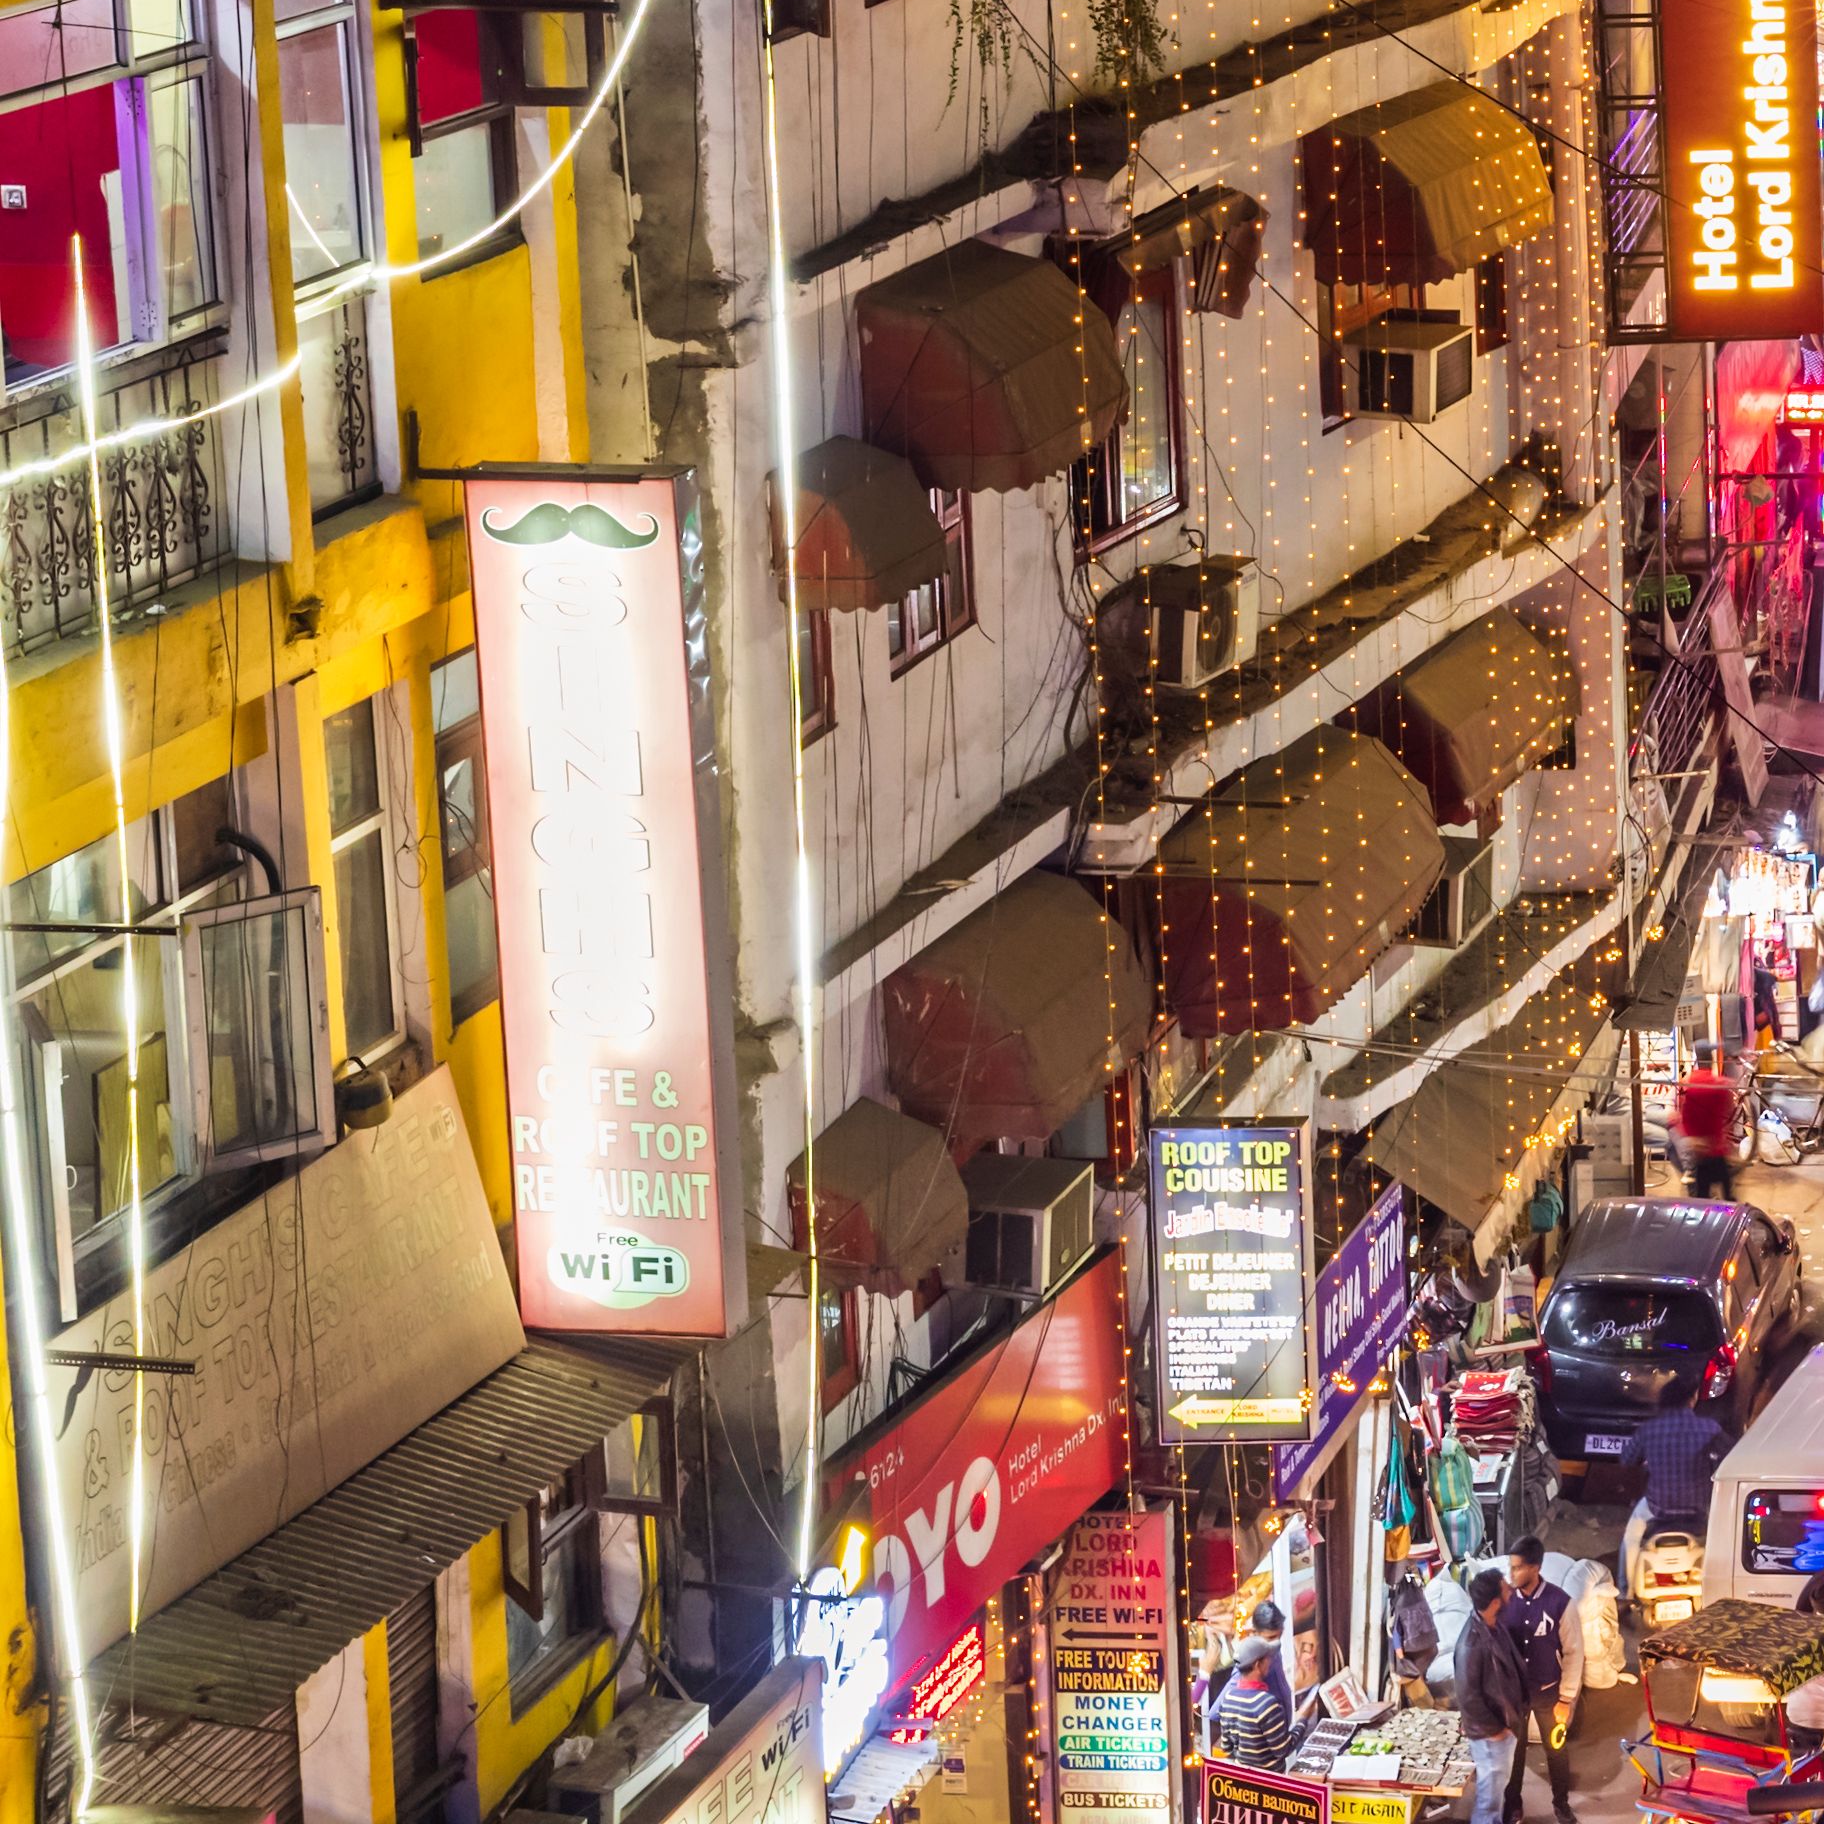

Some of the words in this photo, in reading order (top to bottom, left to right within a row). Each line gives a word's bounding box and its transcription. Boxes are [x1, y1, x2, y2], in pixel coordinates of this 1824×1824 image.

[1690, 150, 1738, 290] Hotel
[1750, 168, 1794, 288] Lord
[652, 1071, 678, 1108] &
[631, 1121, 708, 1161] TOP
[1161, 1142, 1230, 1166] ROOF
[1240, 1142, 1291, 1165] TOP
[1166, 1168, 1287, 1192] COUISINE
[597, 1233, 638, 1246] Free
[1164, 1253, 1209, 1271] PETIT
[1212, 1253, 1295, 1271] DEJEUNER
[1368, 1211, 1402, 1299] TATTOO
[1189, 1273, 1271, 1291] DEJEUNER
[1207, 1293, 1255, 1311] DINER
[1592, 1307, 1667, 1341] Bansal
[1169, 1366, 1218, 1376] ITALIAN
[1170, 1378, 1232, 1390] TIBETAN
[1008, 1434, 1043, 1476] Hotel
[1009, 1469, 1037, 1504] Lord
[1039, 1434, 1084, 1491] Krishna
[874, 1457, 1001, 1636] OYO
[1075, 1533, 1138, 1553] LORD
[1071, 1584, 1103, 1600] DX.
[1111, 1584, 1146, 1600] INN
[1056, 1607, 1106, 1623] FREE
[1114, 1608, 1163, 1624] WI-FI
[1056, 1651, 1093, 1668] FREE
[1058, 1674, 1158, 1692] INFORMATION
[1075, 1696, 1148, 1711] MONEY
[1063, 1717, 1163, 1731] CHANGER
[1064, 1737, 1092, 1750] AIR
[1096, 1738, 1162, 1752] TICKETS
[1067, 1756, 1105, 1768] TRAIN
[1108, 1756, 1160, 1770] TICKETS
[1064, 1794, 1096, 1807] BUS
[1099, 1795, 1167, 1809] TICKETS
[1212, 1778, 1259, 1805] Обмен
[1263, 1793, 1316, 1819] валюты
[1361, 1803, 1406, 1818] AGAIN
